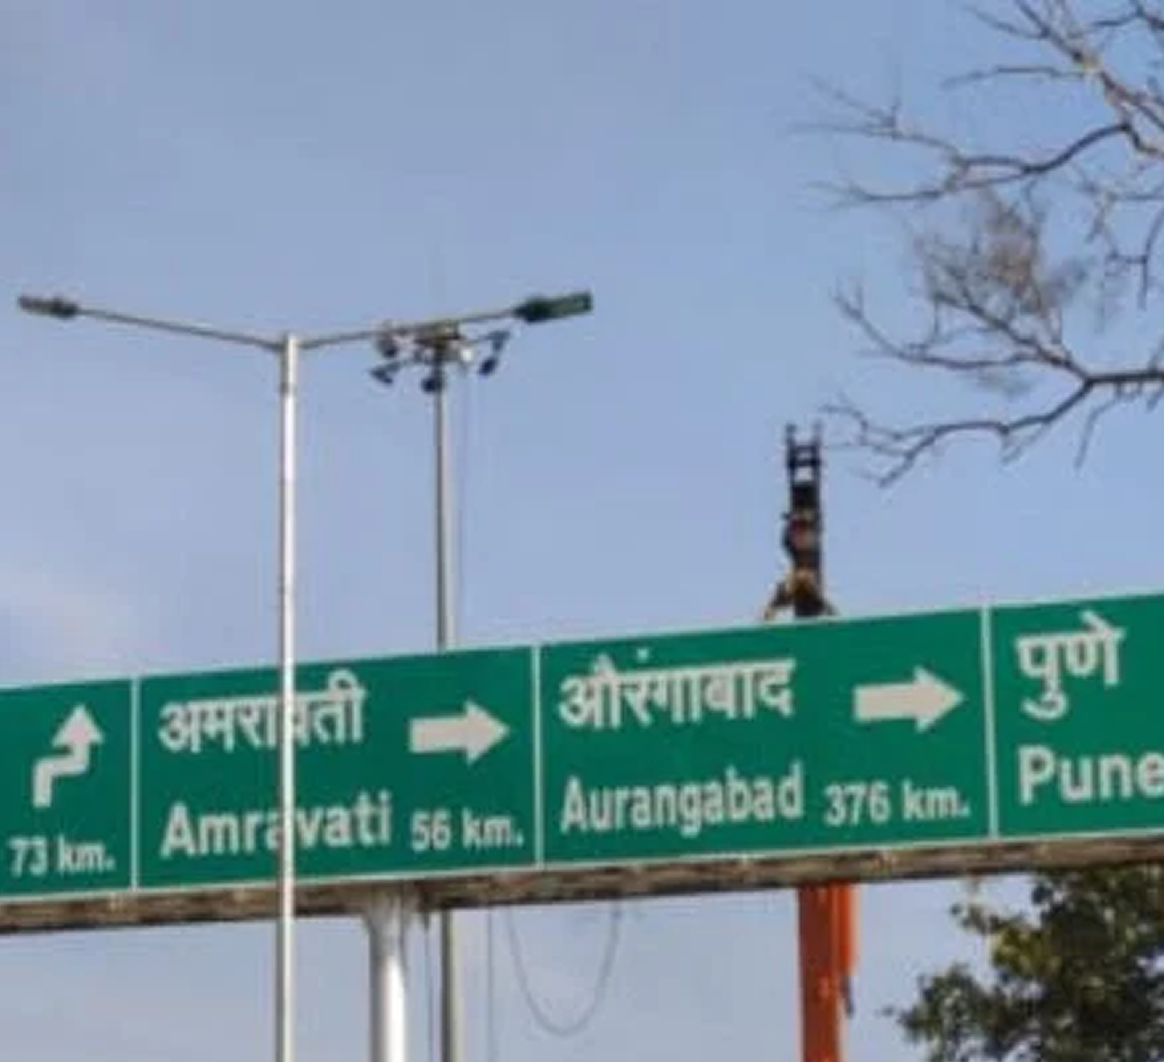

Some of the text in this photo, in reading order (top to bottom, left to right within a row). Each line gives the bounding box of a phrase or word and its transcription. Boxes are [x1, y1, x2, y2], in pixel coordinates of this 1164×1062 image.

[557, 647, 797, 731] औरंगाबाद
[1015, 610, 1126, 721] पुणे
[560, 761, 971, 837] Aurangabad 376 km.
[1018, 744, 1164, 806] Pune
[10, 837, 48, 875] 73
[57, 836, 116, 873] km.
[411, 810, 451, 852] 56
[462, 807, 524, 849] km.
